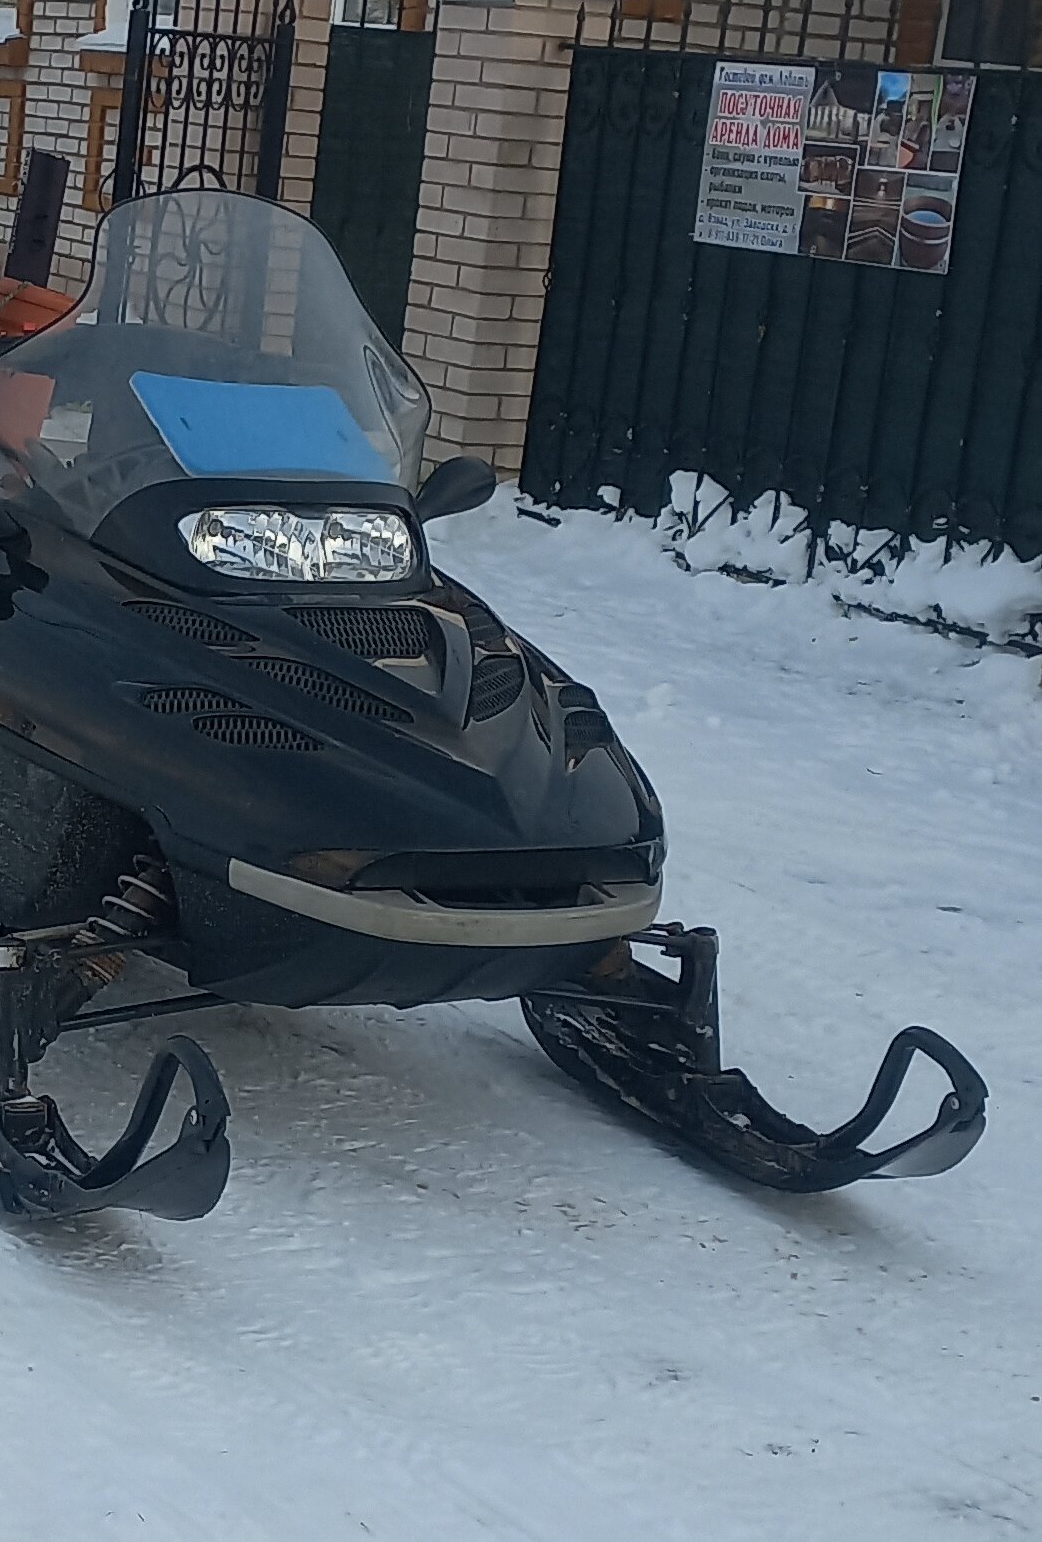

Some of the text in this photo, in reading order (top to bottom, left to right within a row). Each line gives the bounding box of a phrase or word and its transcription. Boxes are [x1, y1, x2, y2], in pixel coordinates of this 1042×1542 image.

[718, 91, 803, 120] ПОСУТОЧНАЯ
[710, 120, 799, 150] АРЕНДА ДОМА
